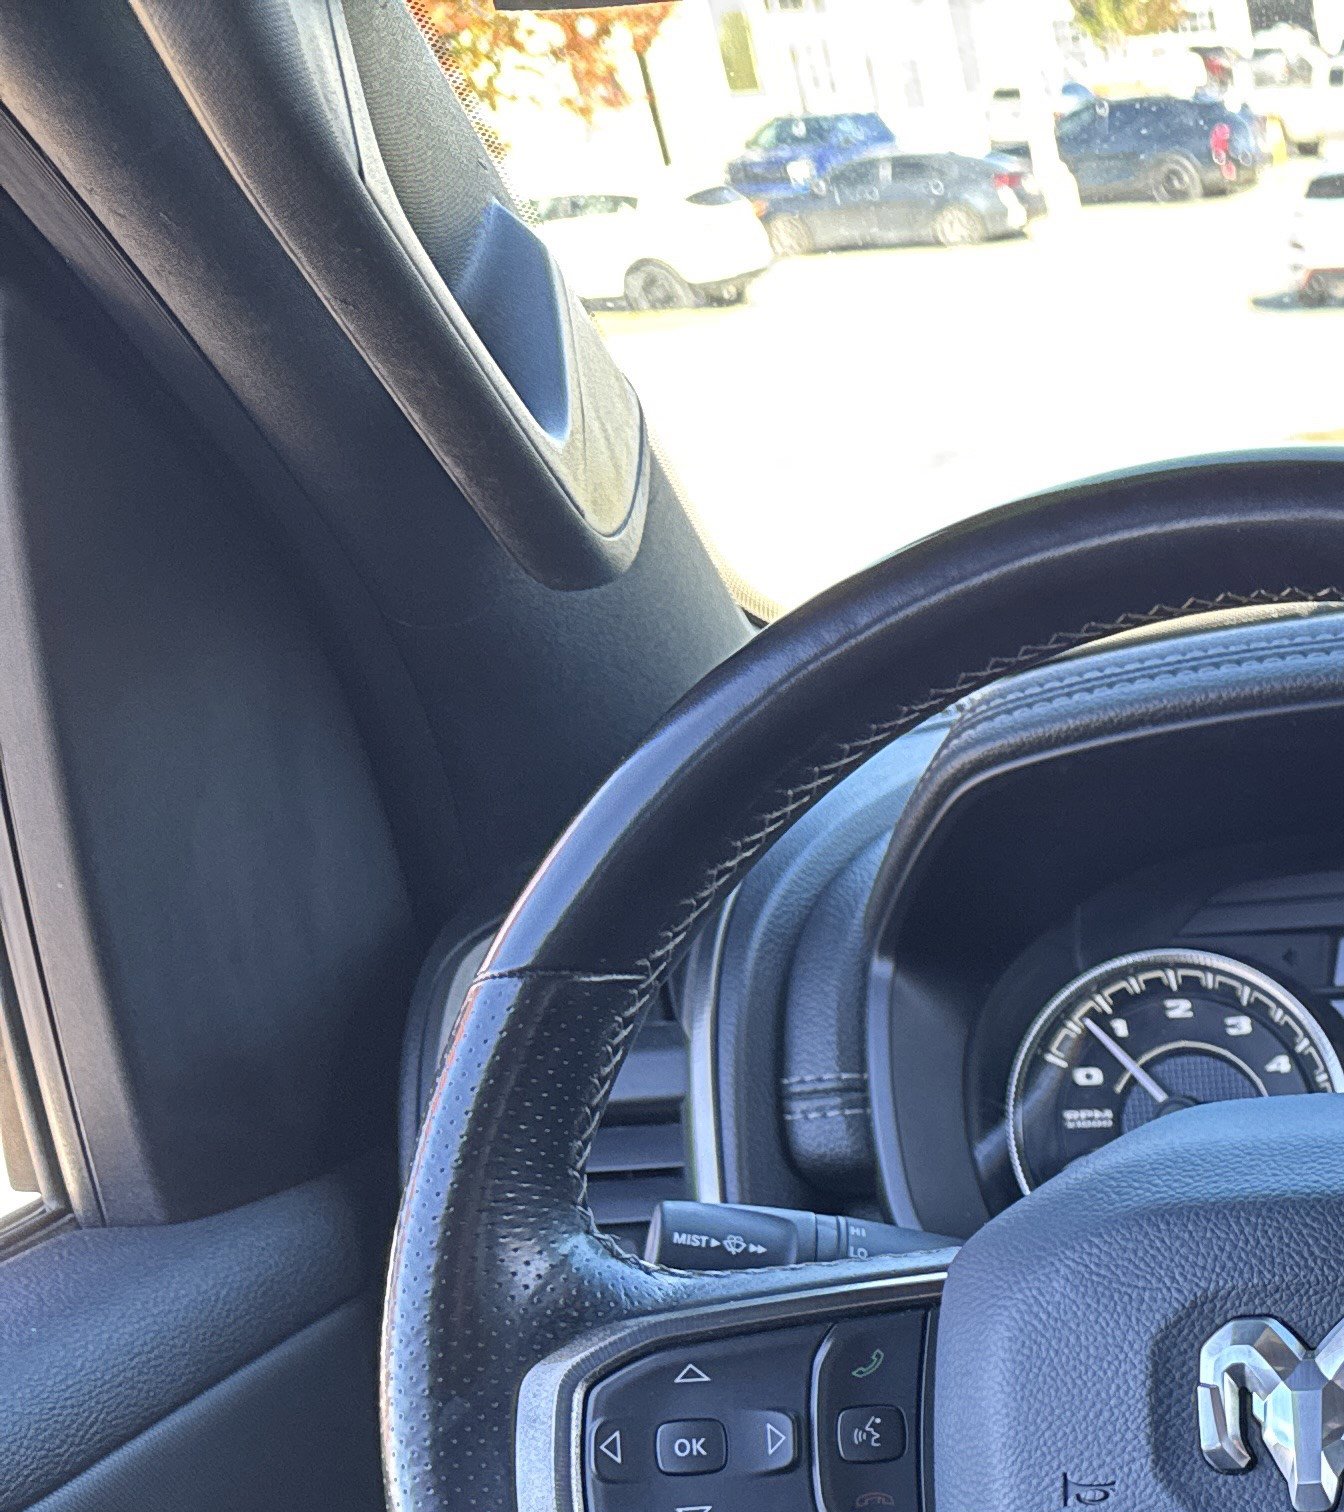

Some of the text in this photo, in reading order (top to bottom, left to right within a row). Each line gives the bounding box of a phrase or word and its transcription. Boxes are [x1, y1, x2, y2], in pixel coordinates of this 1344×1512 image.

[1164, 999, 1194, 1019] 2
[1110, 1017, 1129, 1038] 1
[1224, 1015, 1252, 1036] 3
[1264, 1054, 1292, 1074] 4
[1072, 1066, 1105, 1087] 0
[672, 1231, 710, 1248] MIST
[673, 1437, 707, 1458] OK
